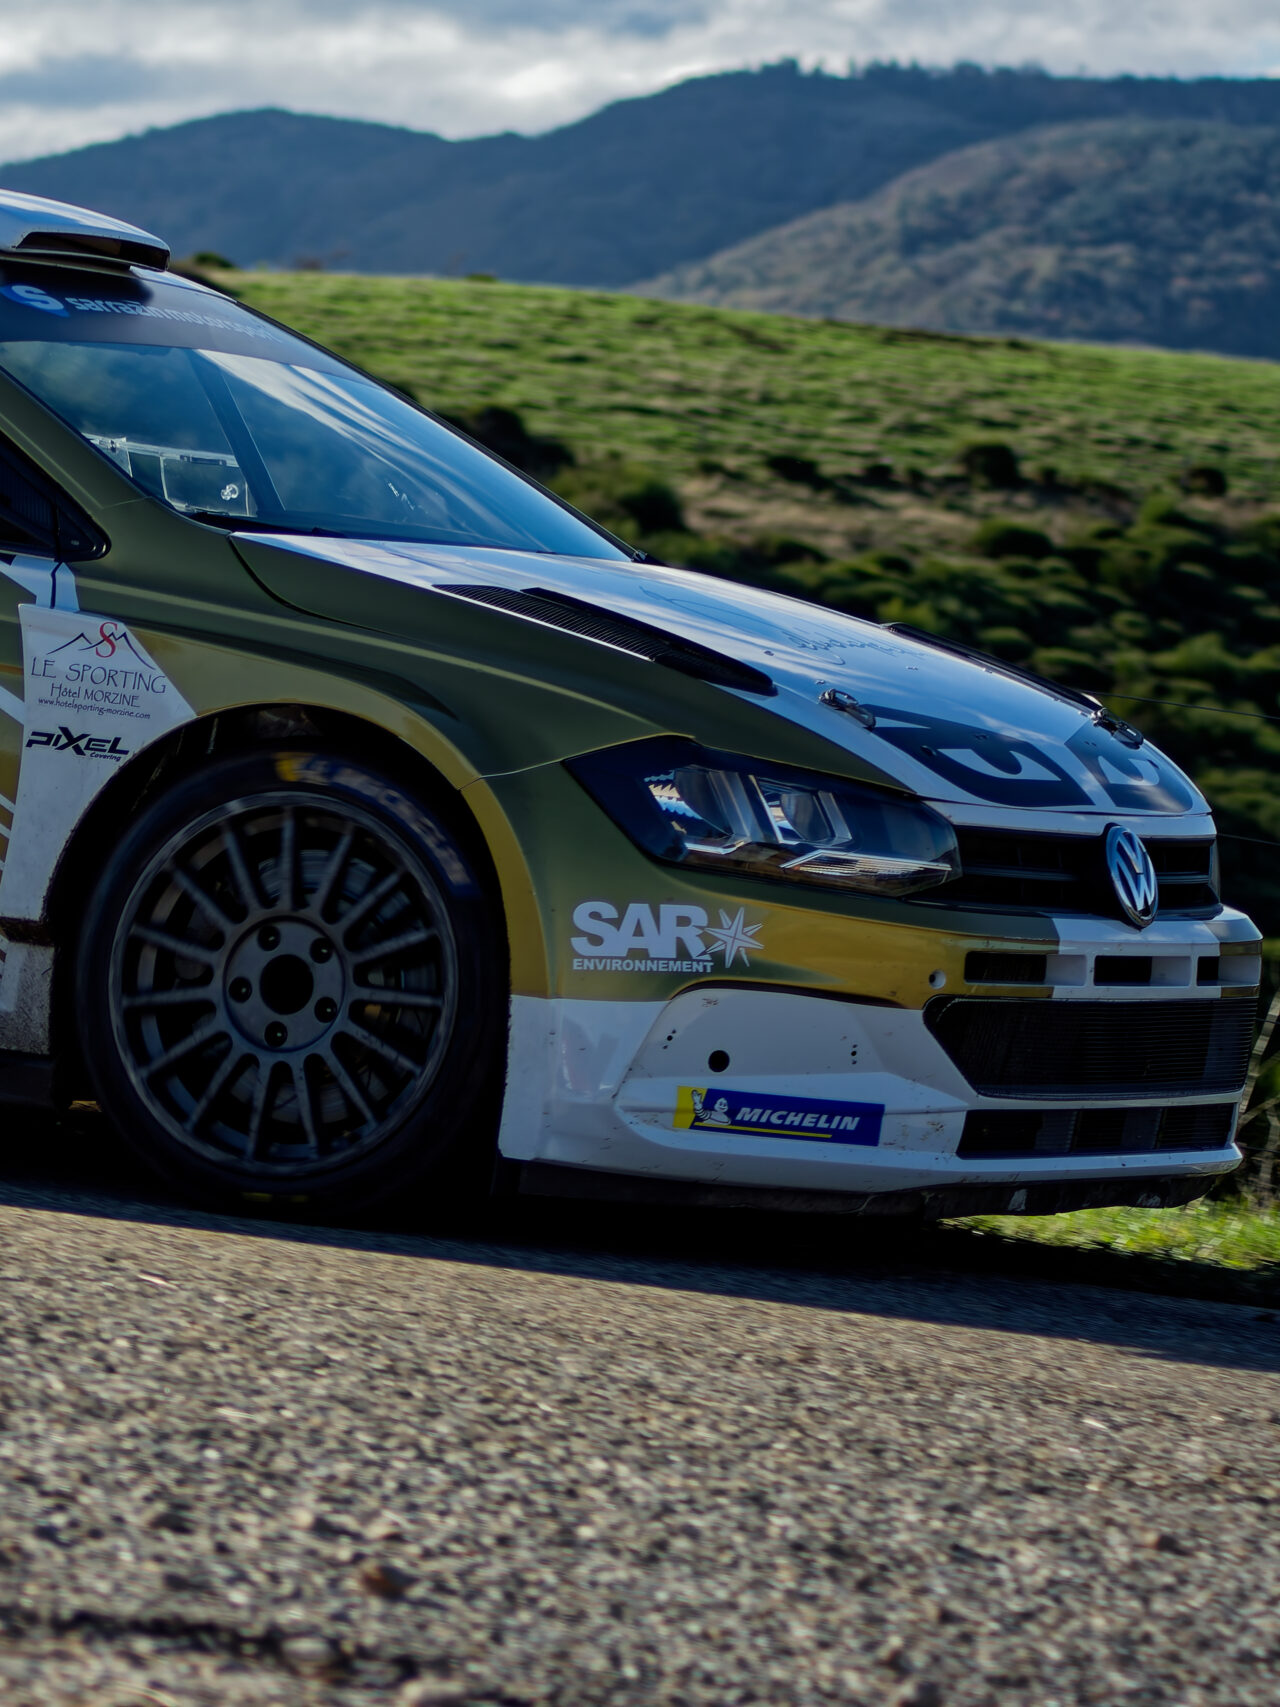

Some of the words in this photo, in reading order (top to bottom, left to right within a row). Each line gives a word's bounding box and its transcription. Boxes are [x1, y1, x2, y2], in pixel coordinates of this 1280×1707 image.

[31, 657, 56, 678] LE
[65, 664, 167, 694] SPORTING
[50, 683, 81, 698] Hôtel
[84, 689, 141, 708] MORZINE
[38, 697, 151, 719] www.hotelsporting-morzine.com
[90, 752, 122, 762] Covering
[570, 901, 712, 960] SAR
[572, 958, 715, 973] ENVIRONNEMENT
[735, 1107, 860, 1131] MICHELIN
